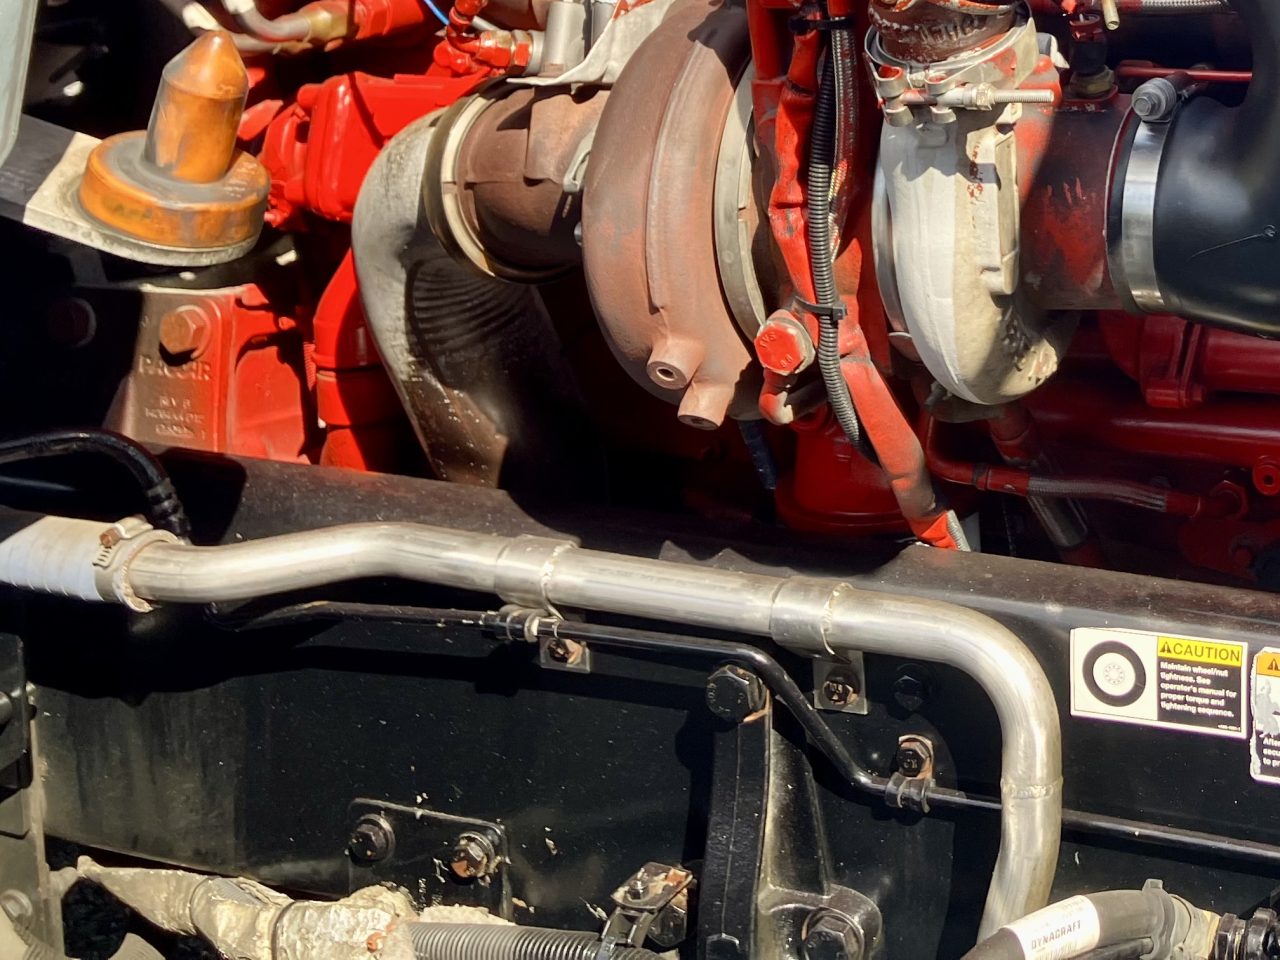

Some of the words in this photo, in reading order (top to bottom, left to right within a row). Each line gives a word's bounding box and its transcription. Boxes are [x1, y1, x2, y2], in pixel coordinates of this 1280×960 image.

[1173, 642, 1240, 662] CAUTION
[1160, 661, 1192, 672] Maintain
[1192, 666, 1229, 678] wheel/nut
[1160, 671, 1196, 683] tightness.
[1196, 675, 1212, 685] See
[1160, 682, 1197, 693] operator's
[1198, 688, 1225, 697] manual
[1225, 690, 1238, 698] for
[1160, 692, 1185, 701] proper
[1185, 695, 1210, 705] torque
[1160, 701, 1197, 714] tightening
[1197, 706, 1235, 718] sequence.
[1263, 757, 1271, 766] to
